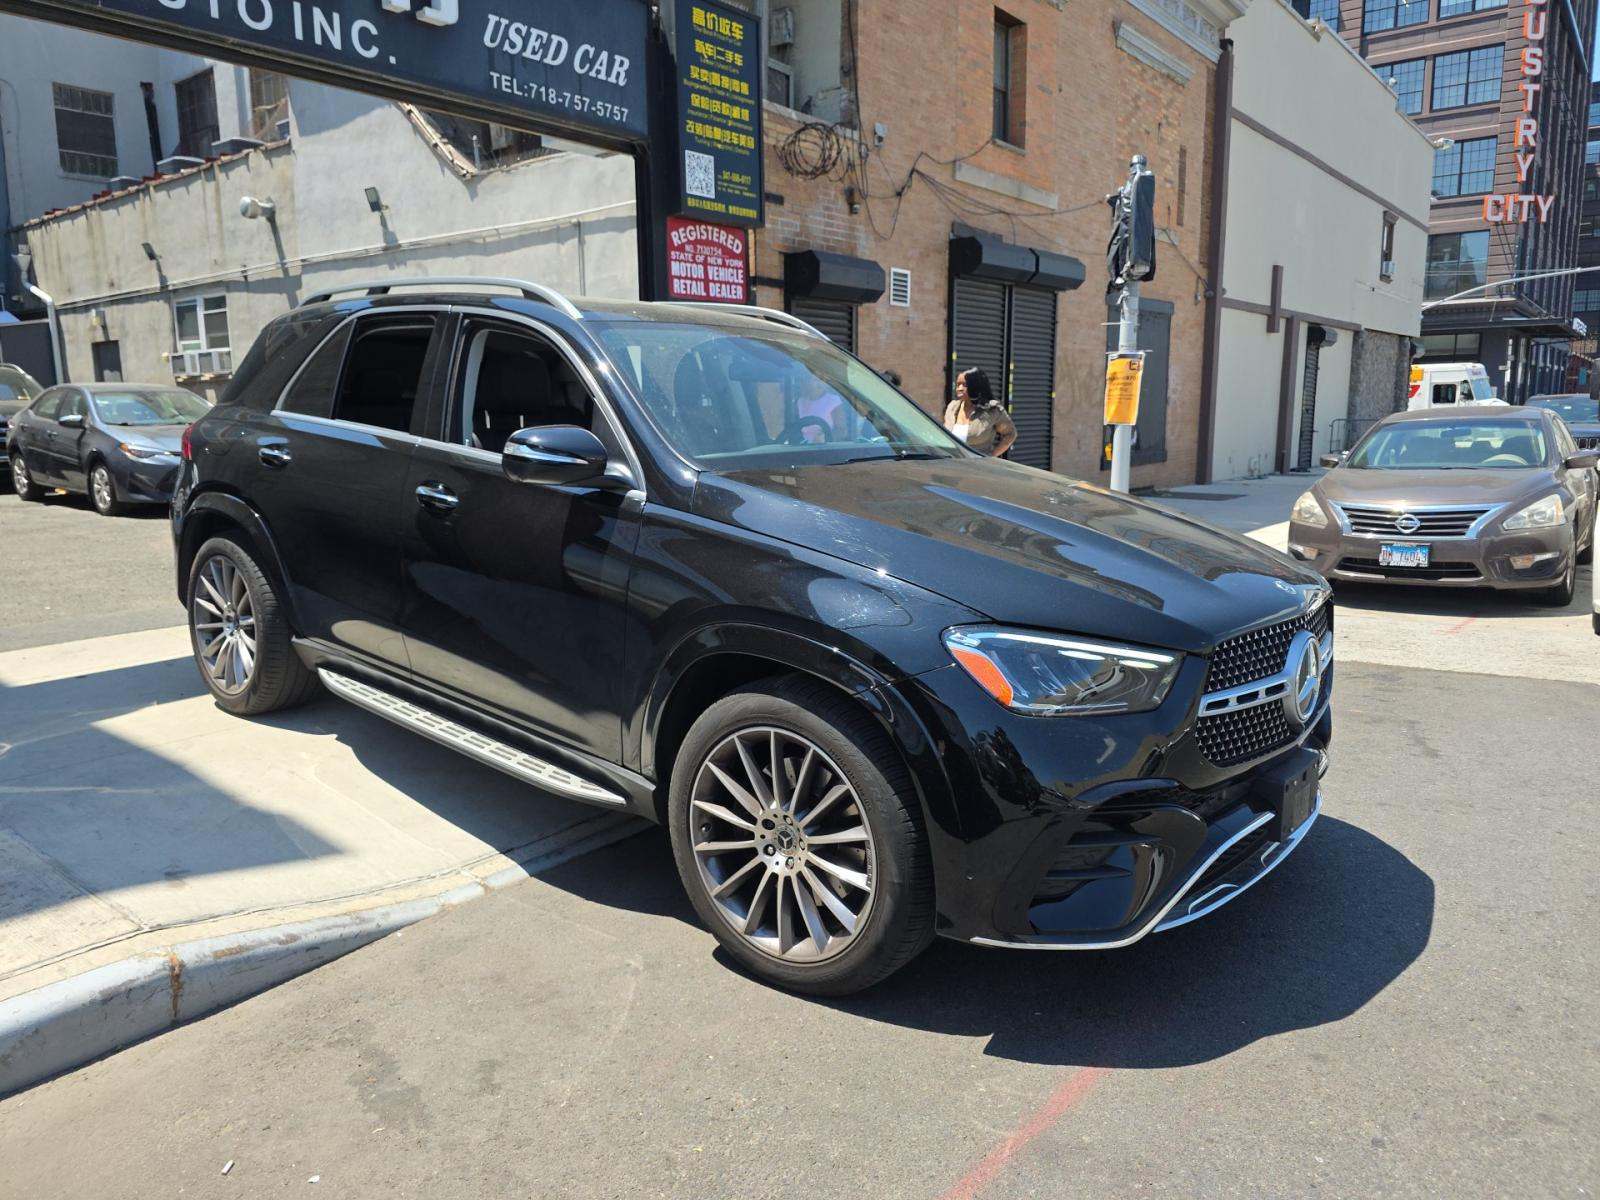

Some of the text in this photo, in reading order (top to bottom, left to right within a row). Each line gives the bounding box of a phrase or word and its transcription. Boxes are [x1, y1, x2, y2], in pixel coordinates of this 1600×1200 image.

[293, 1, 396, 65] INC.
[482, 13, 569, 67] USED
[573, 43, 630, 87] CAR
[1514, 0, 1546, 182] USTRY
[1484, 194, 1555, 223] CITY
[671, 225, 742, 254] REGISTERED
[670, 250, 744, 269] STATE OF NEW YORK
[670, 260, 744, 285] MOTOR VEHICLE
[672, 278, 743, 300] RETAIL DEALER
